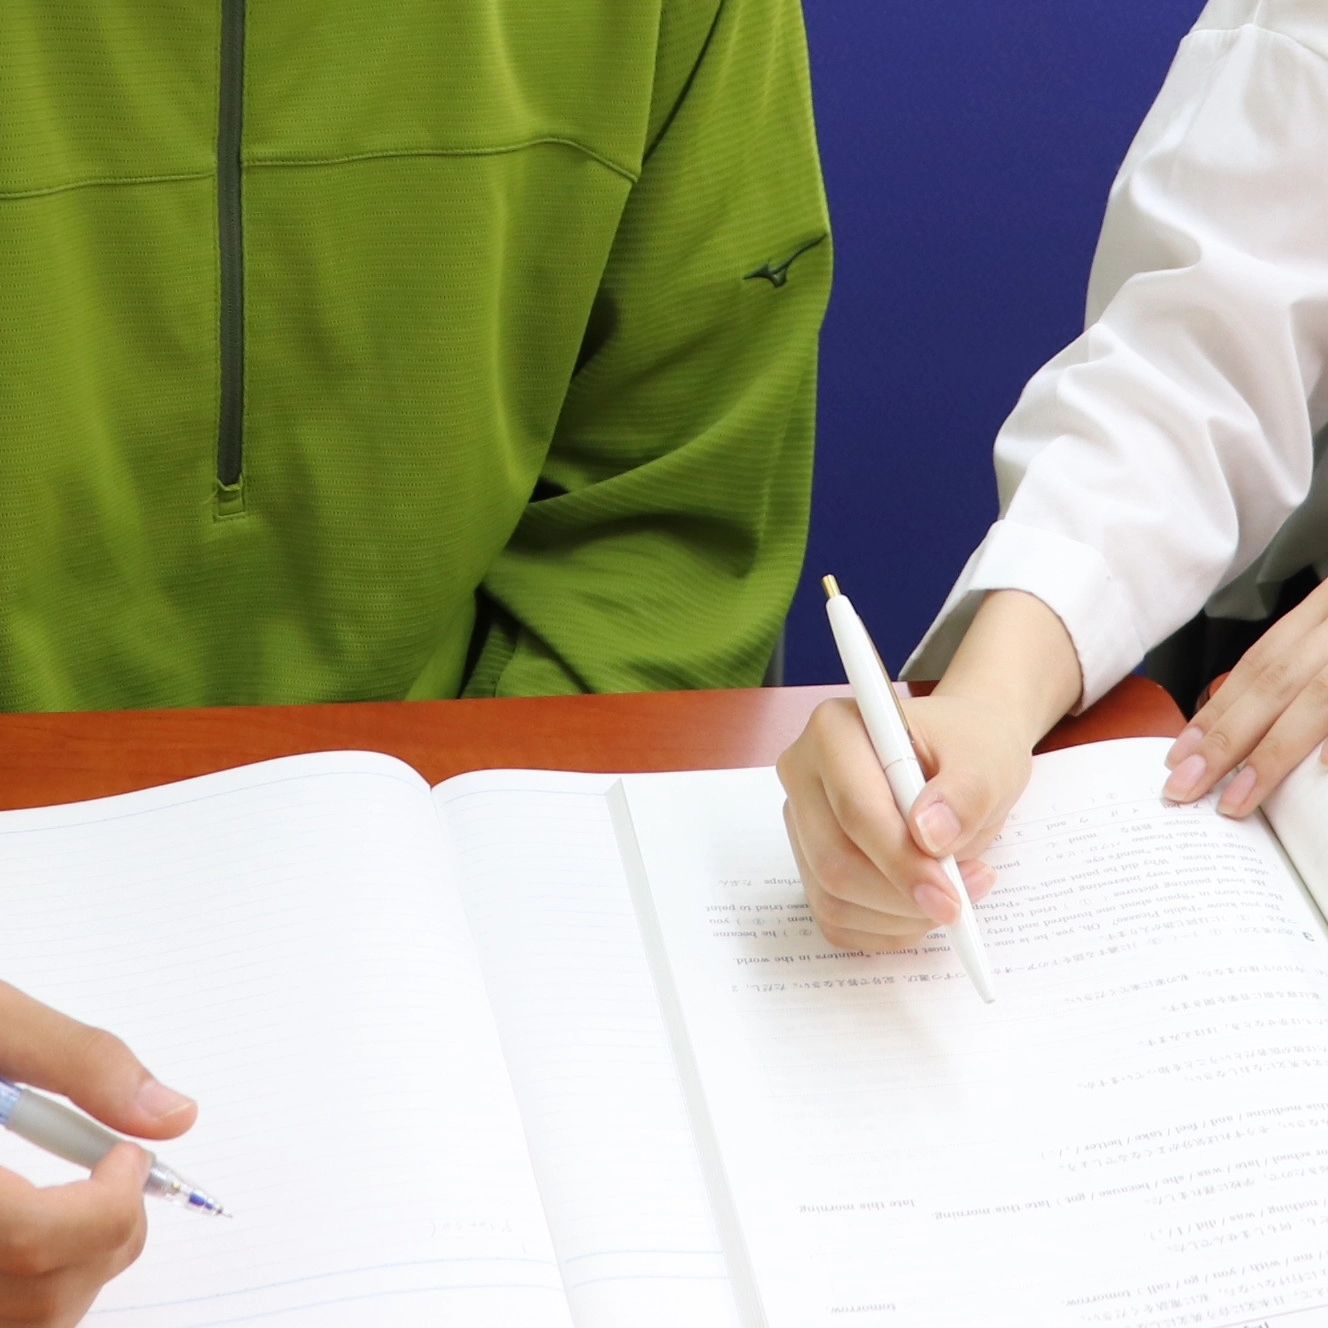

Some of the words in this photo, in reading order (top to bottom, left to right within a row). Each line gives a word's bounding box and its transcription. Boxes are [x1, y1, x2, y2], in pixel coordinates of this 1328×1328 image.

[1068, 833, 1096, 844] mind
[1121, 863, 1139, 871] did
[1070, 869, 1099, 881] paint
[764, 877, 801, 886] erhaps
[1040, 878, 1066, 888] such
[1078, 875, 1141, 891] interesting
[1113, 883, 1159, 896] pictures
[707, 904, 736, 912] paint
[973, 901, 1019, 911] Perhap
[1120, 899, 1152, 909] about
[1029, 906, 1057, 917] tried
[984, 915, 1008, 923] find
[1043, 911, 1093, 927] hundred
[1112, 911, 1160, 926] Picasso?
[987, 926, 1014, 934] forty
[1018, 922, 1039, 932] and
[1052, 927, 1074, 936] yes,
[1079, 923, 1100, 931] Oh,
[713, 931, 758, 939] became
[922, 946, 950, 954] most
[1246, 1105, 1303, 1117] medicine
[1210, 1116, 1233, 1126] and
[1175, 1123, 1198, 1134] feel
[1135, 1131, 1162, 1140] take
[1085, 1139, 1123, 1150] better
[1272, 1152, 1311, 1164] school
[1235, 1160, 1260, 1169] late
[1197, 1168, 1222, 1176] was
[1162, 1176, 1184, 1184] she
[1099, 1182, 1150, 1196] because
[1065, 1193, 1085, 1203] got
[860, 1202, 884, 1210] this
[890, 1199, 915, 1208] late
[1025, 1200, 1050, 1208] late
[1267, 1200, 1318, 1214] nothing
[995, 1205, 1020, 1213] this
[1230, 1212, 1255, 1221] was
[1196, 1220, 1216, 1231] did
[1293, 1253, 1313, 1262] me
[1250, 1260, 1280, 1272] with
[1213, 1267, 1237, 1278] you
[1184, 1275, 1199, 1284] go
[1147, 1283, 1170, 1295] call
